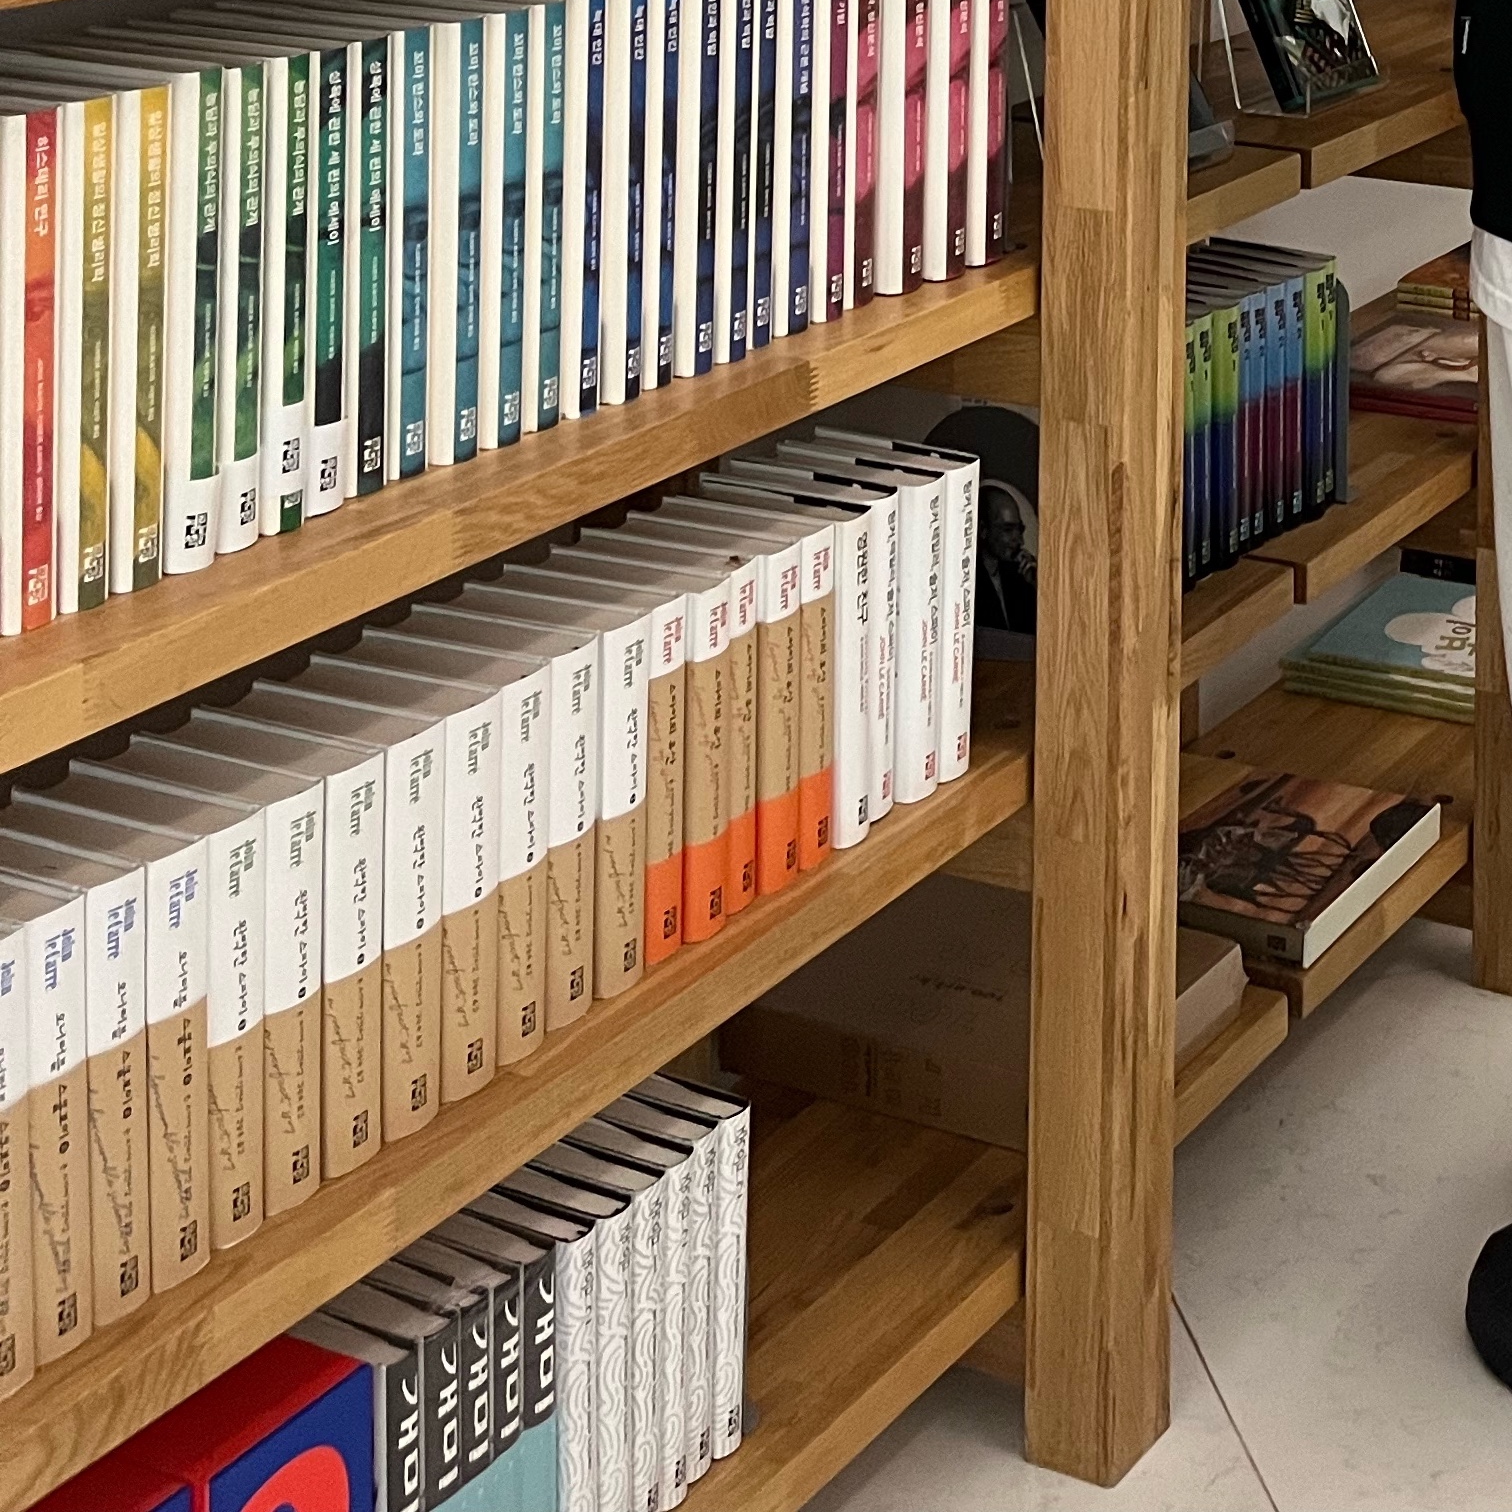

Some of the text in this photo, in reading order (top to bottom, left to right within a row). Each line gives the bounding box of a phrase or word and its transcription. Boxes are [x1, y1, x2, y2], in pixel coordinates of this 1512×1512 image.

[33, 137, 49, 237] 히스테리 연구
[857, 532, 868, 626] 영원한 친구
[468, 1315, 489, 1463] 개미
[501, 1297, 519, 1438] 개미
[535, 1272, 554, 1414] 개미
[398, 1374, 418, 1512] 개미
[438, 1342, 458, 1490] 개미
